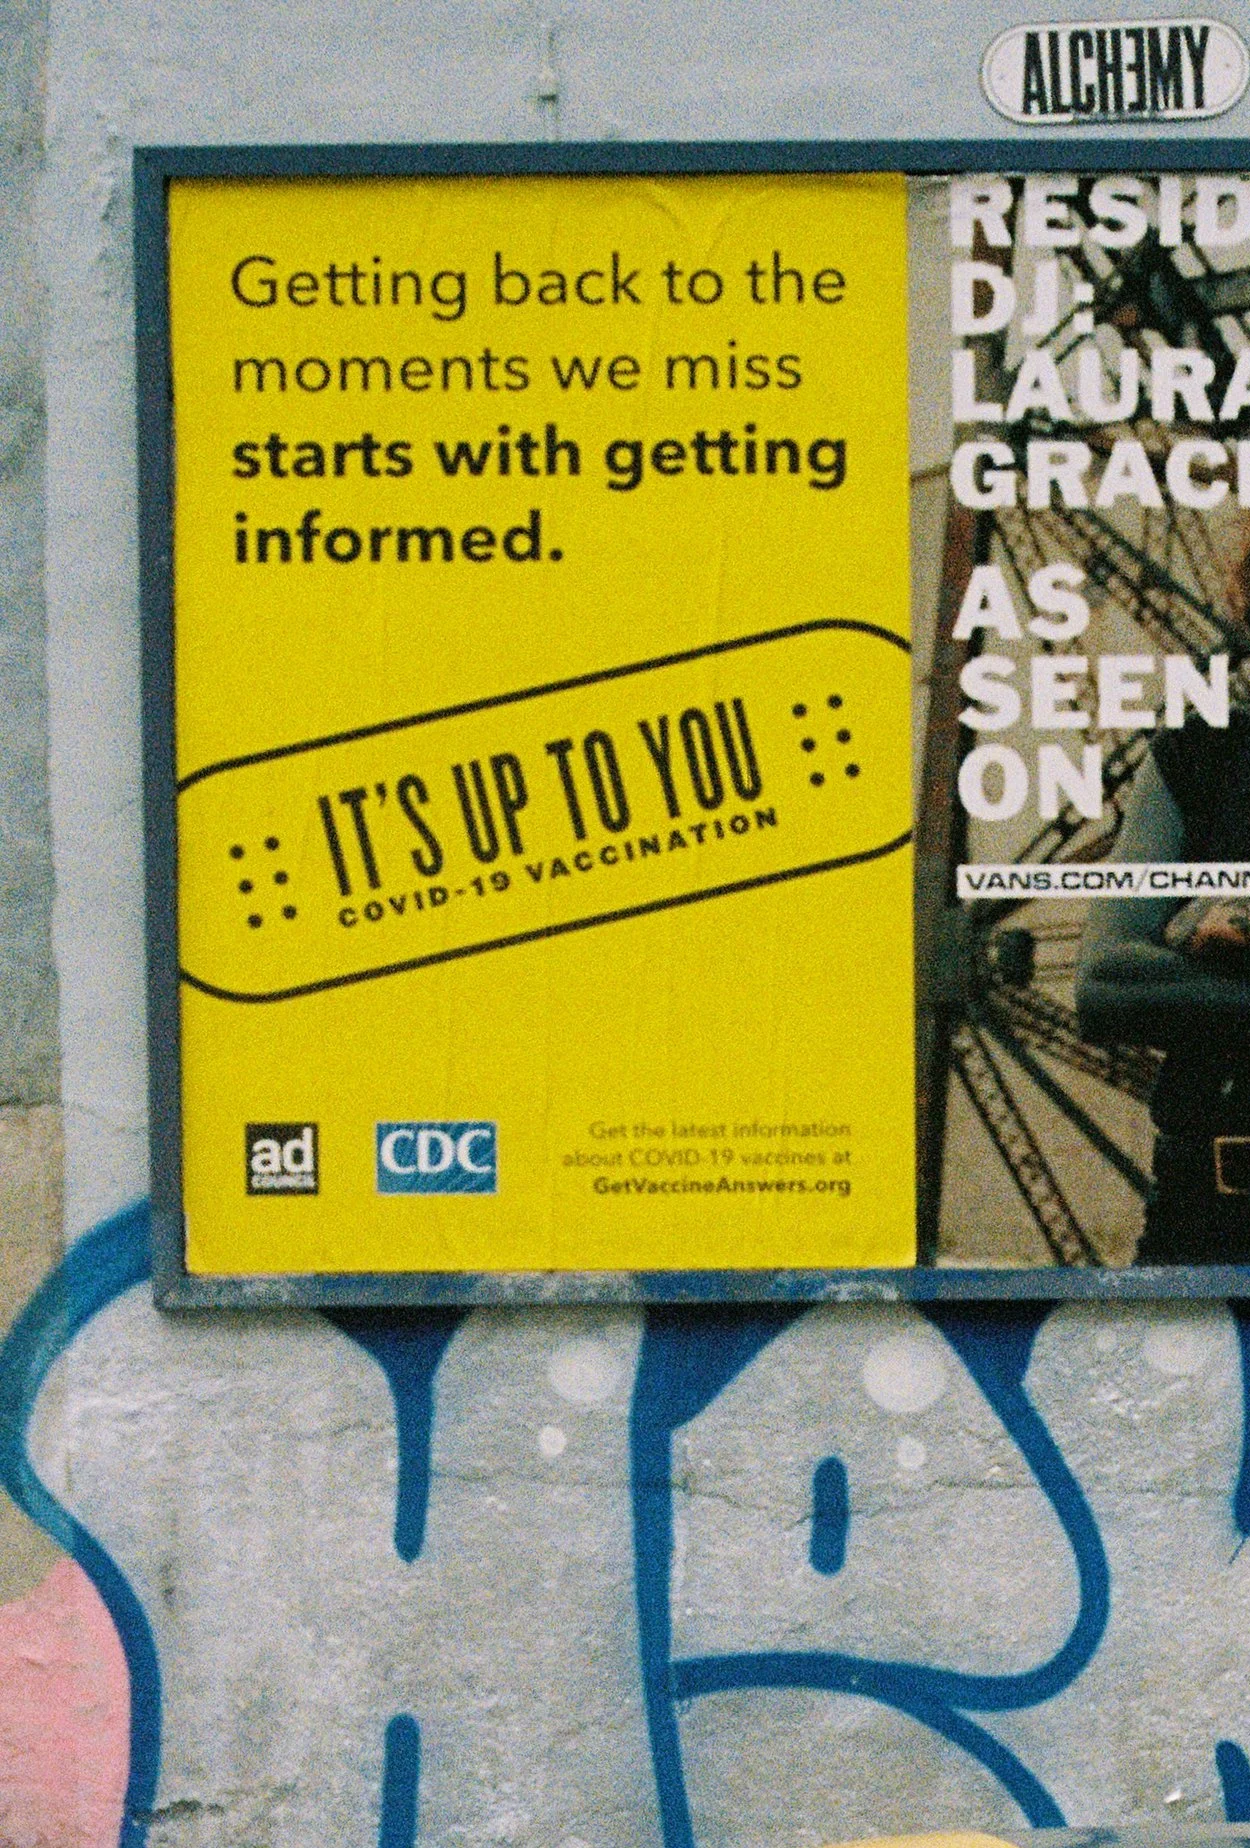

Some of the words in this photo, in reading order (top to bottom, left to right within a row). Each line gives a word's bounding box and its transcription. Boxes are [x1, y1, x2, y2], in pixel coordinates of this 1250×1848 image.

[231, 255, 468, 321] Getting
[494, 251, 642, 305] back
[665, 261, 724, 305] to
[748, 251, 847, 304] the
[951, 260, 1095, 335] DJ:
[232, 347, 531, 393] moments
[552, 355, 642, 391] we
[666, 340, 802, 391] miss
[232, 432, 414, 479] starts
[435, 423, 580, 476] with
[604, 423, 847, 491] getting
[233, 509, 566, 564] informed.
[952, 564, 1090, 641] AS
[958, 653, 1230, 730] SEEN
[451, 752, 529, 864] UP
[545, 729, 632, 841] TO
[638, 697, 764, 819] YOU
[958, 743, 1103, 821] ON
[338, 869, 511, 929] COVID-19
[525, 806, 778, 884] VACCINATION
[251, 1127, 314, 1174] ad
[380, 1129, 492, 1174] CDC
[562, 1150, 623, 1167] about
[741, 1149, 826, 1166] vaccines
[832, 1150, 851, 1166] at
[589, 1121, 626, 1139] Get
[633, 1121, 666, 1138] the
[671, 1121, 726, 1138] latest
[733, 1120, 851, 1138] information
[592, 1175, 851, 1197] GetVaccineAnswers.org
